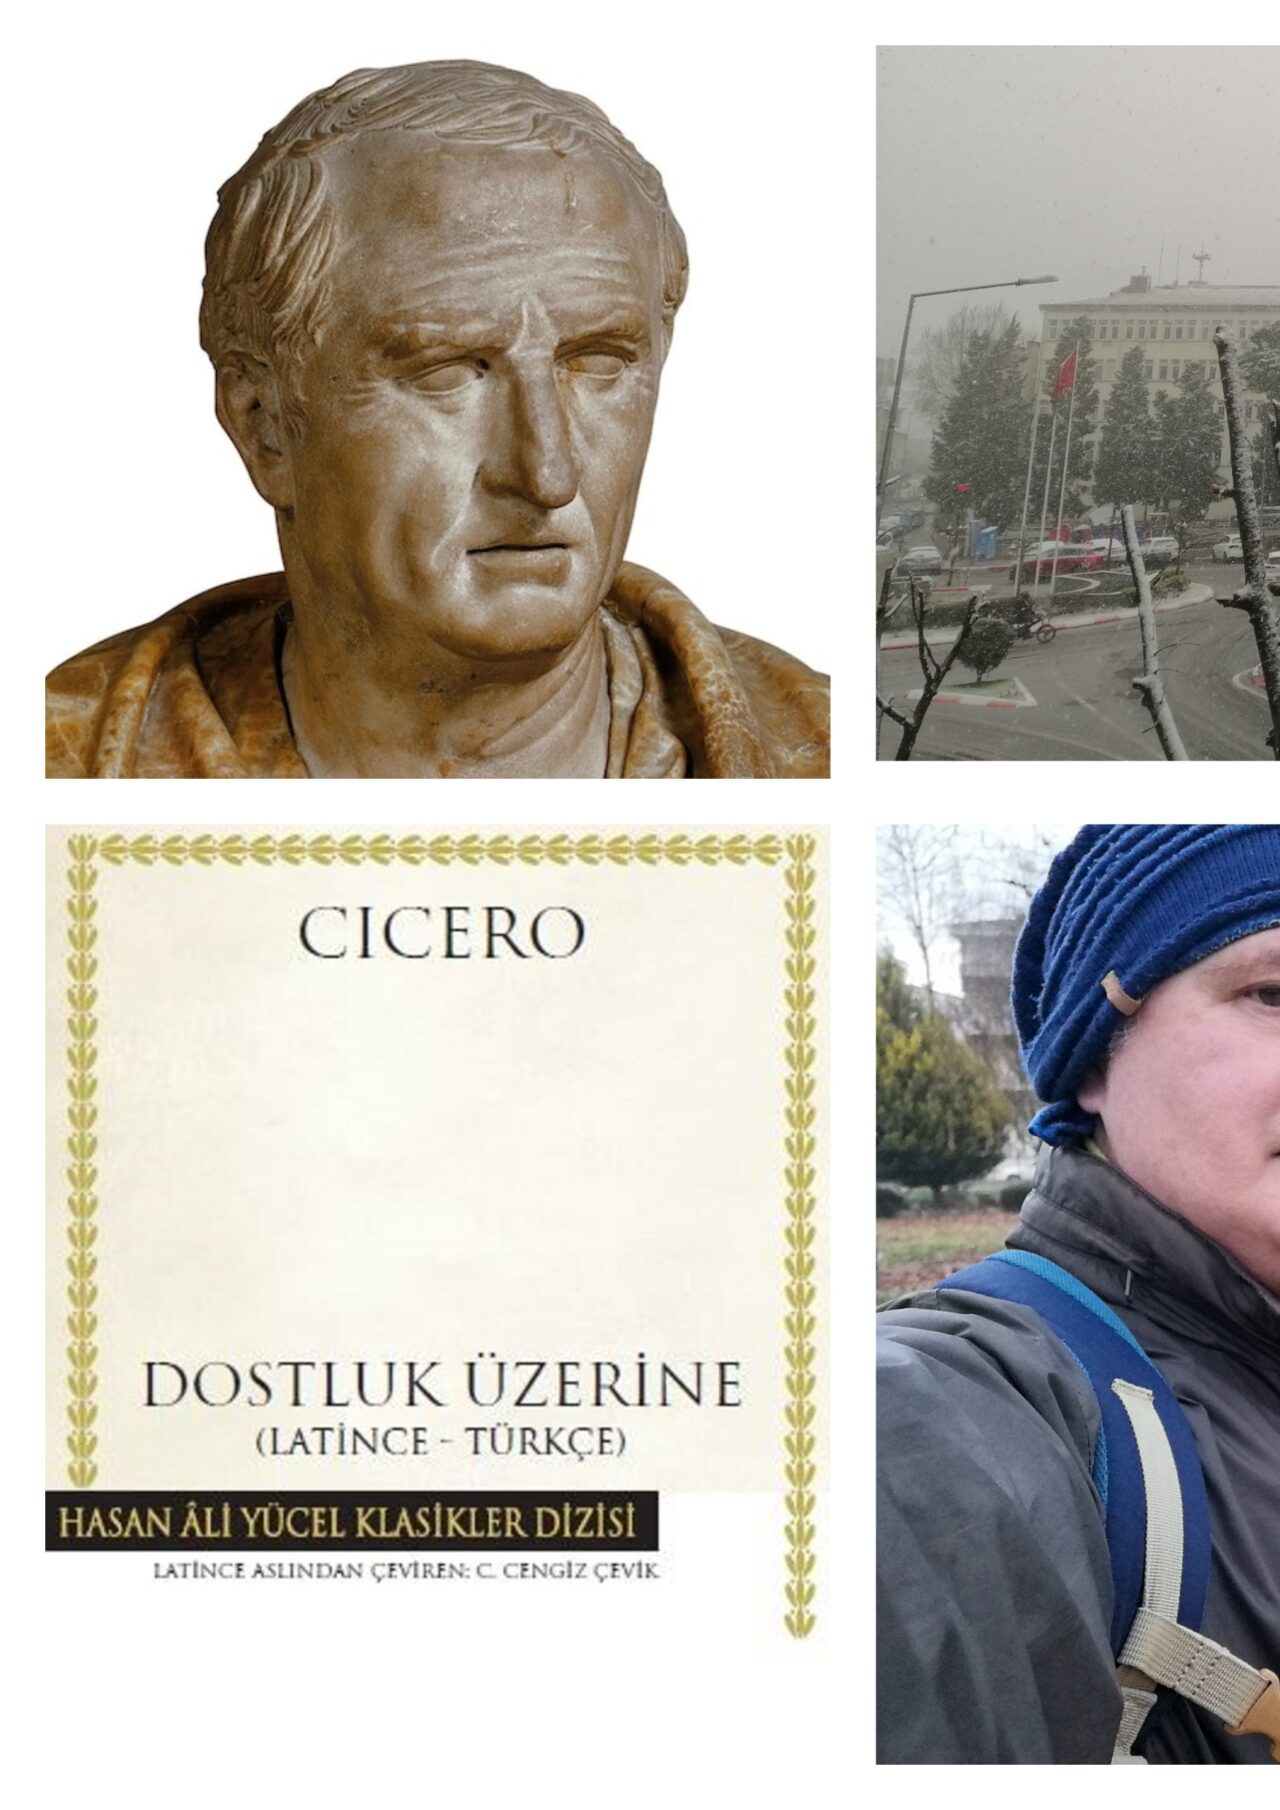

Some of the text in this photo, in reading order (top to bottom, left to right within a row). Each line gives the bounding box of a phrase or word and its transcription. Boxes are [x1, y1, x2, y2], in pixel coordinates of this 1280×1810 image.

[298, 906, 587, 960] CICERO
[143, 1352, 742, 1408] DOSTLUK ÜZERİNE
[255, 1422, 430, 1457] (LATİNCE
[464, 1422, 627, 1462] TÜRKÇE)
[58, 1500, 636, 1539] HASAN ÂLİ YÜCEL KLASİKLER DİZİSİ
[153, 1560, 245, 1580] LATİNCE
[251, 1562, 363, 1580] ASLINDAN
[370, 1560, 471, 1585] ÇEVİREN:
[502, 1560, 587, 1580] CENGİZ
[593, 1560, 660, 1585] ÇEVİK
